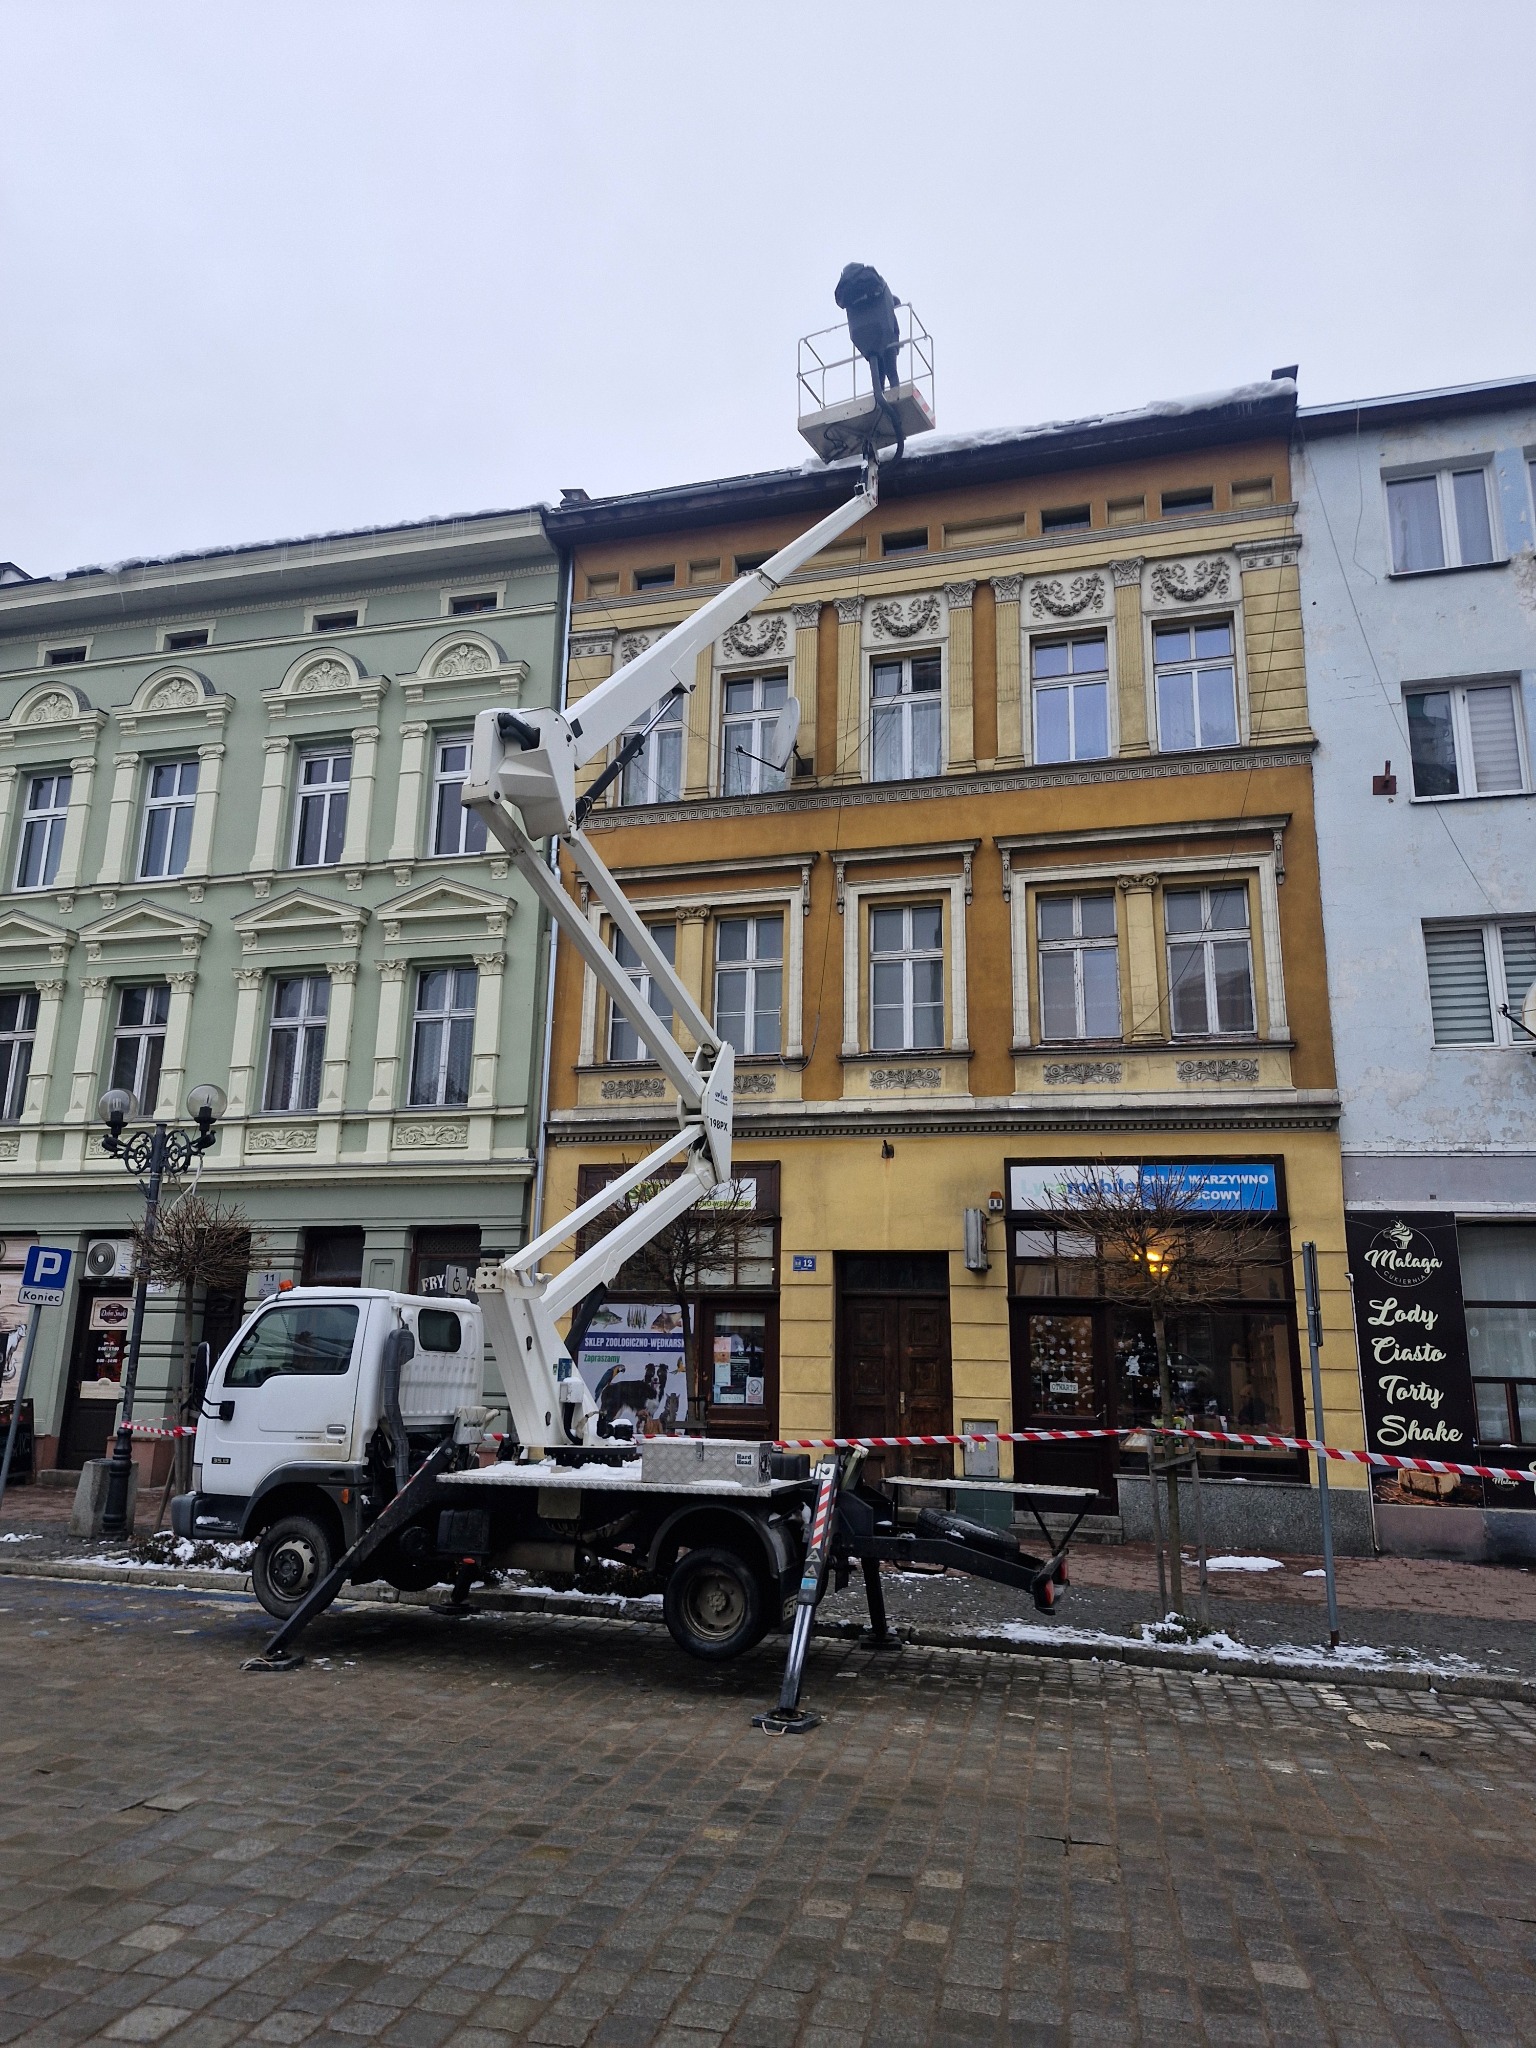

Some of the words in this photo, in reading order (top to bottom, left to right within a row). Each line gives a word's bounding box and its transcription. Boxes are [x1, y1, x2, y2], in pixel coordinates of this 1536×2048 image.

[1189, 1174, 1269, 1185] WARZYWNO
[33, 1251, 63, 1282] P
[803, 1259, 813, 1267] 12
[1364, 1249, 1443, 1274] Malaga
[1383, 1270, 1426, 1285] CUKIERNIA
[23, 1290, 60, 1303] Koniec
[1368, 1297, 1439, 1330] Lody
[584, 1337, 604, 1347] SKLEP
[1371, 1336, 1447, 1365] Ciasto
[584, 1354, 620, 1363] Zapraszamy
[1378, 1375, 1444, 1409] Torty
[1377, 1415, 1463, 1446] Shake
